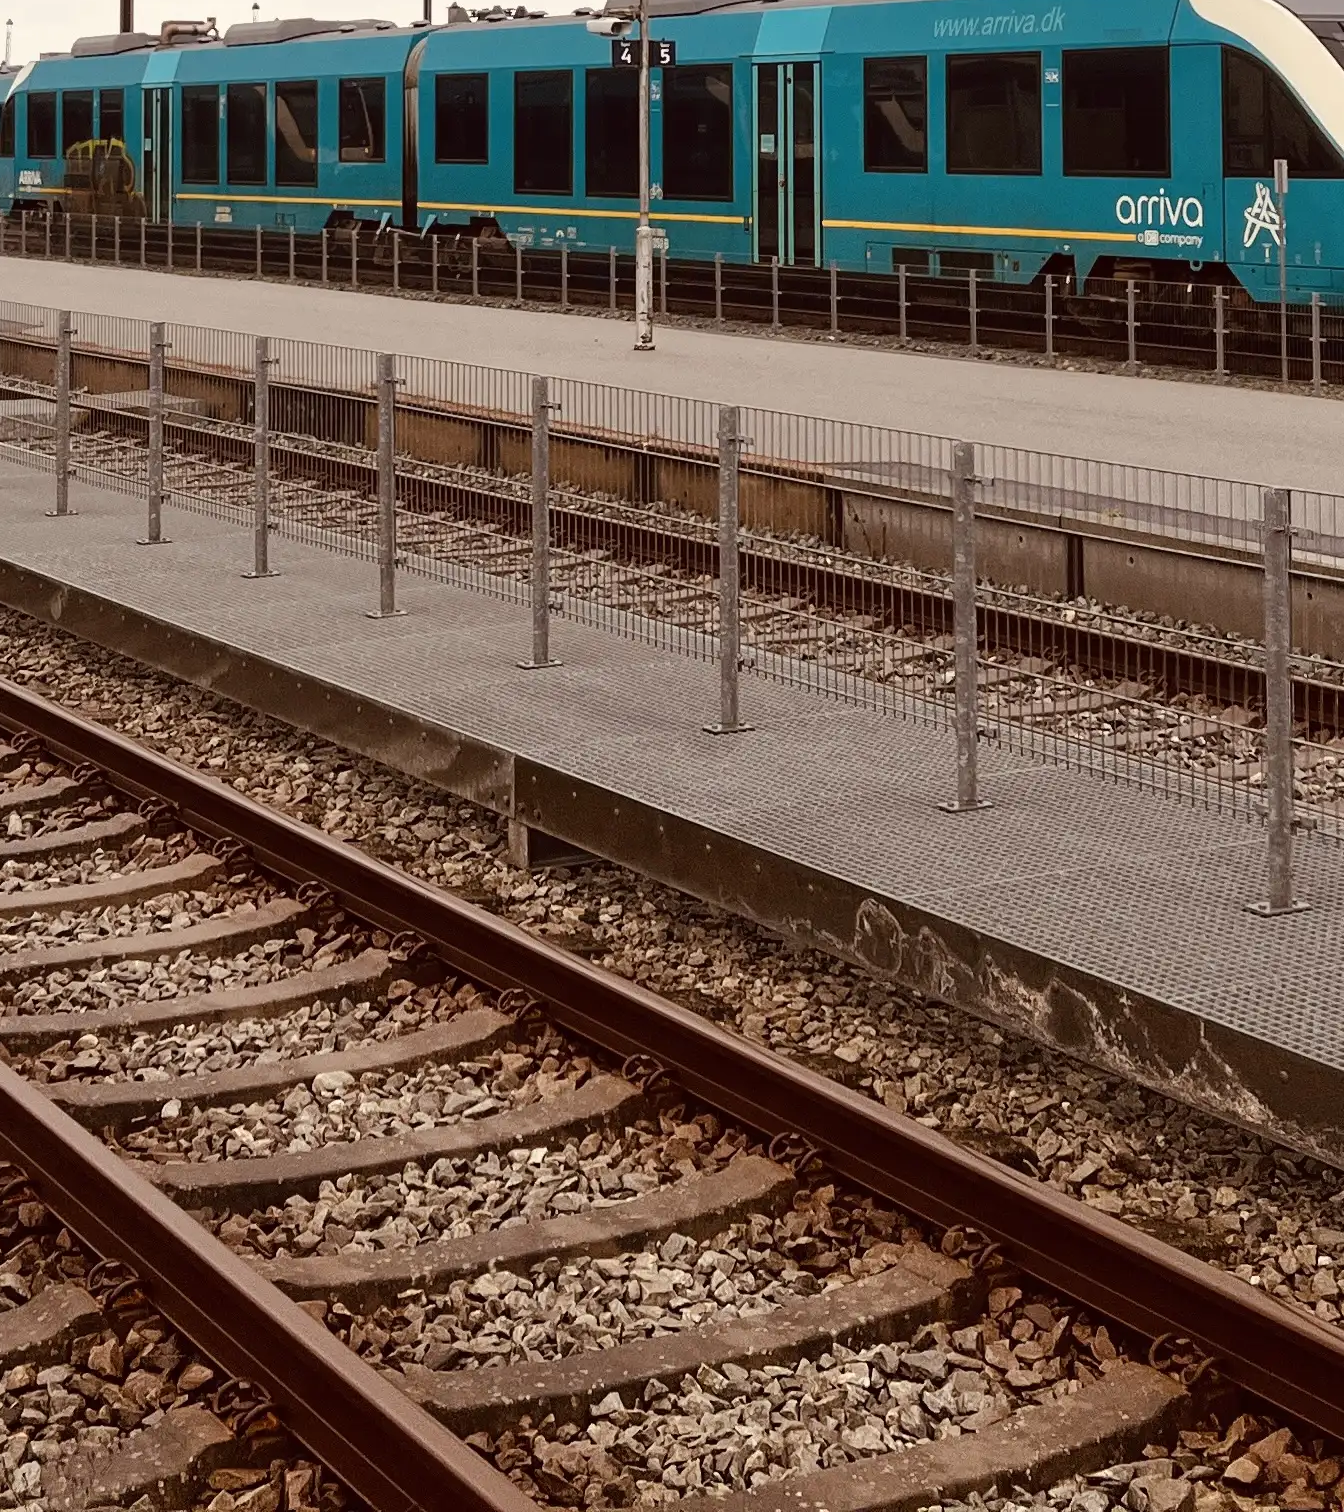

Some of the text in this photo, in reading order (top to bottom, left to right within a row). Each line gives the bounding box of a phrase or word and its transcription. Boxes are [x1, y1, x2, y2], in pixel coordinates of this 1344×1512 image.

[934, 6, 1066, 38] www.arriva.dk
[621, 47, 632, 64] 4
[660, 48, 671, 64] 5
[1116, 187, 1203, 227] arriva
[1159, 233, 1203, 249] company
